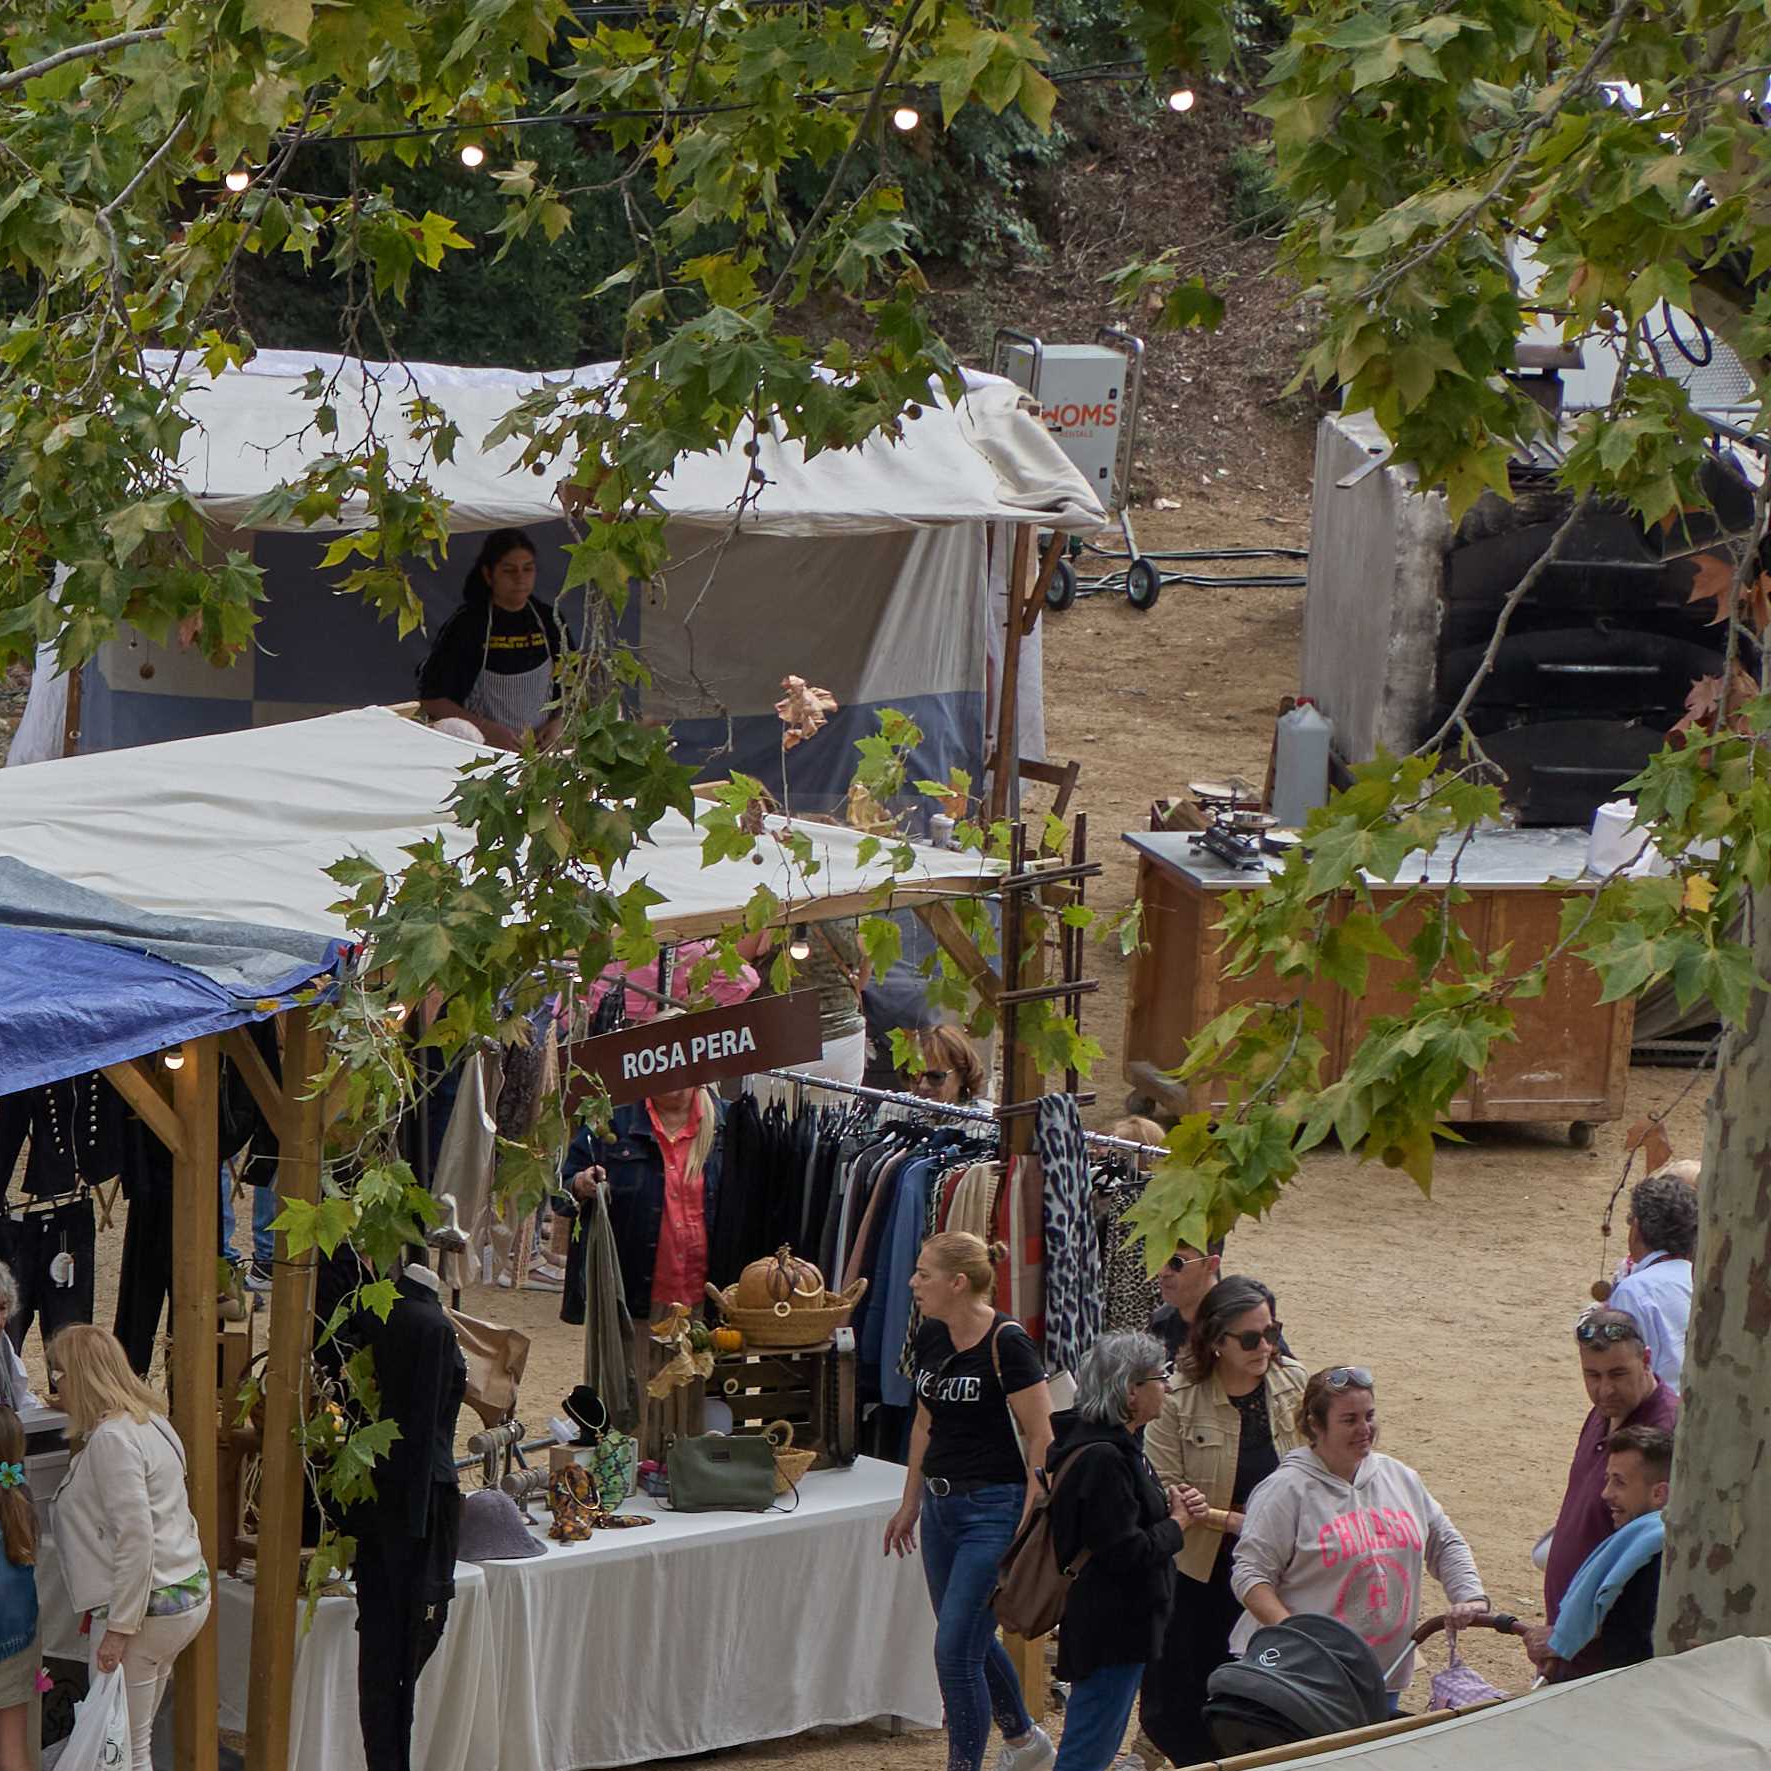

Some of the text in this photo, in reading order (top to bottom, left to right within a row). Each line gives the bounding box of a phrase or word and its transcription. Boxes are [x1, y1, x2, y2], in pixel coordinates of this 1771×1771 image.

[623, 1026, 756, 1080] ROSA PERA
[1319, 1506, 1422, 1568] CHICAGO
